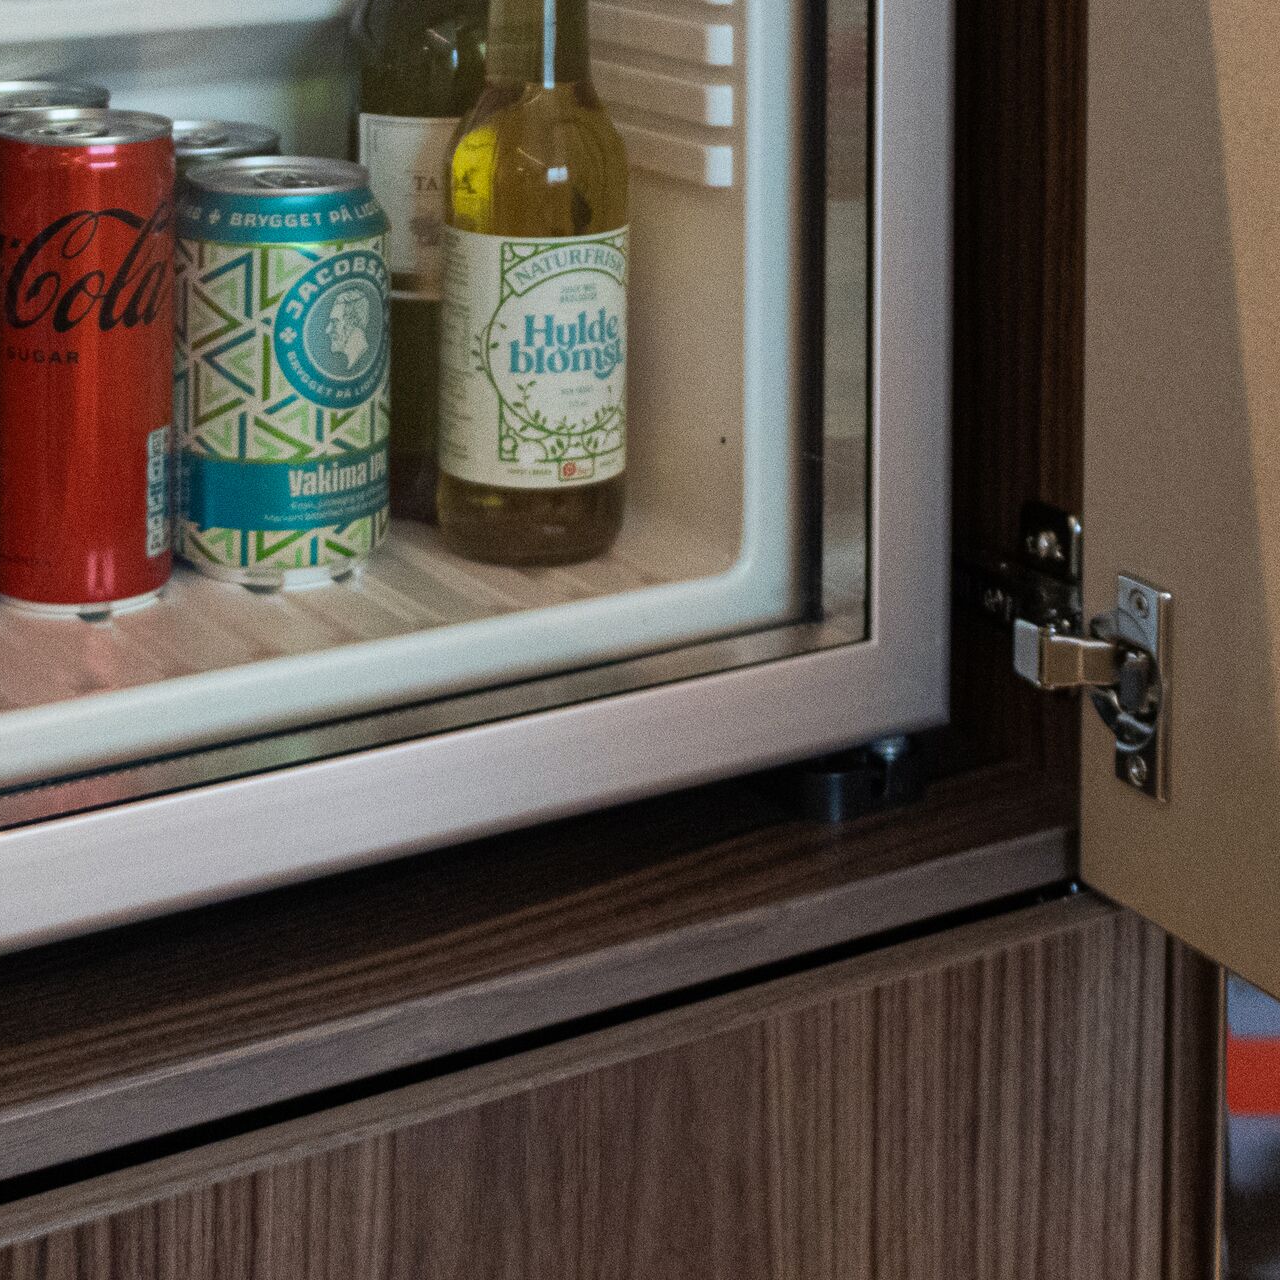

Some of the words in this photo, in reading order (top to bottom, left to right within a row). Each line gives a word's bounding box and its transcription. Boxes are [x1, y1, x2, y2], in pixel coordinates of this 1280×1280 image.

[229, 211, 323, 228] BRYGGET
[329, 204, 353, 224] PÅ
[523, 306, 619, 350] Hylde
[7, 346, 79, 365] SUGAR
[288, 460, 367, 498] Yakima
